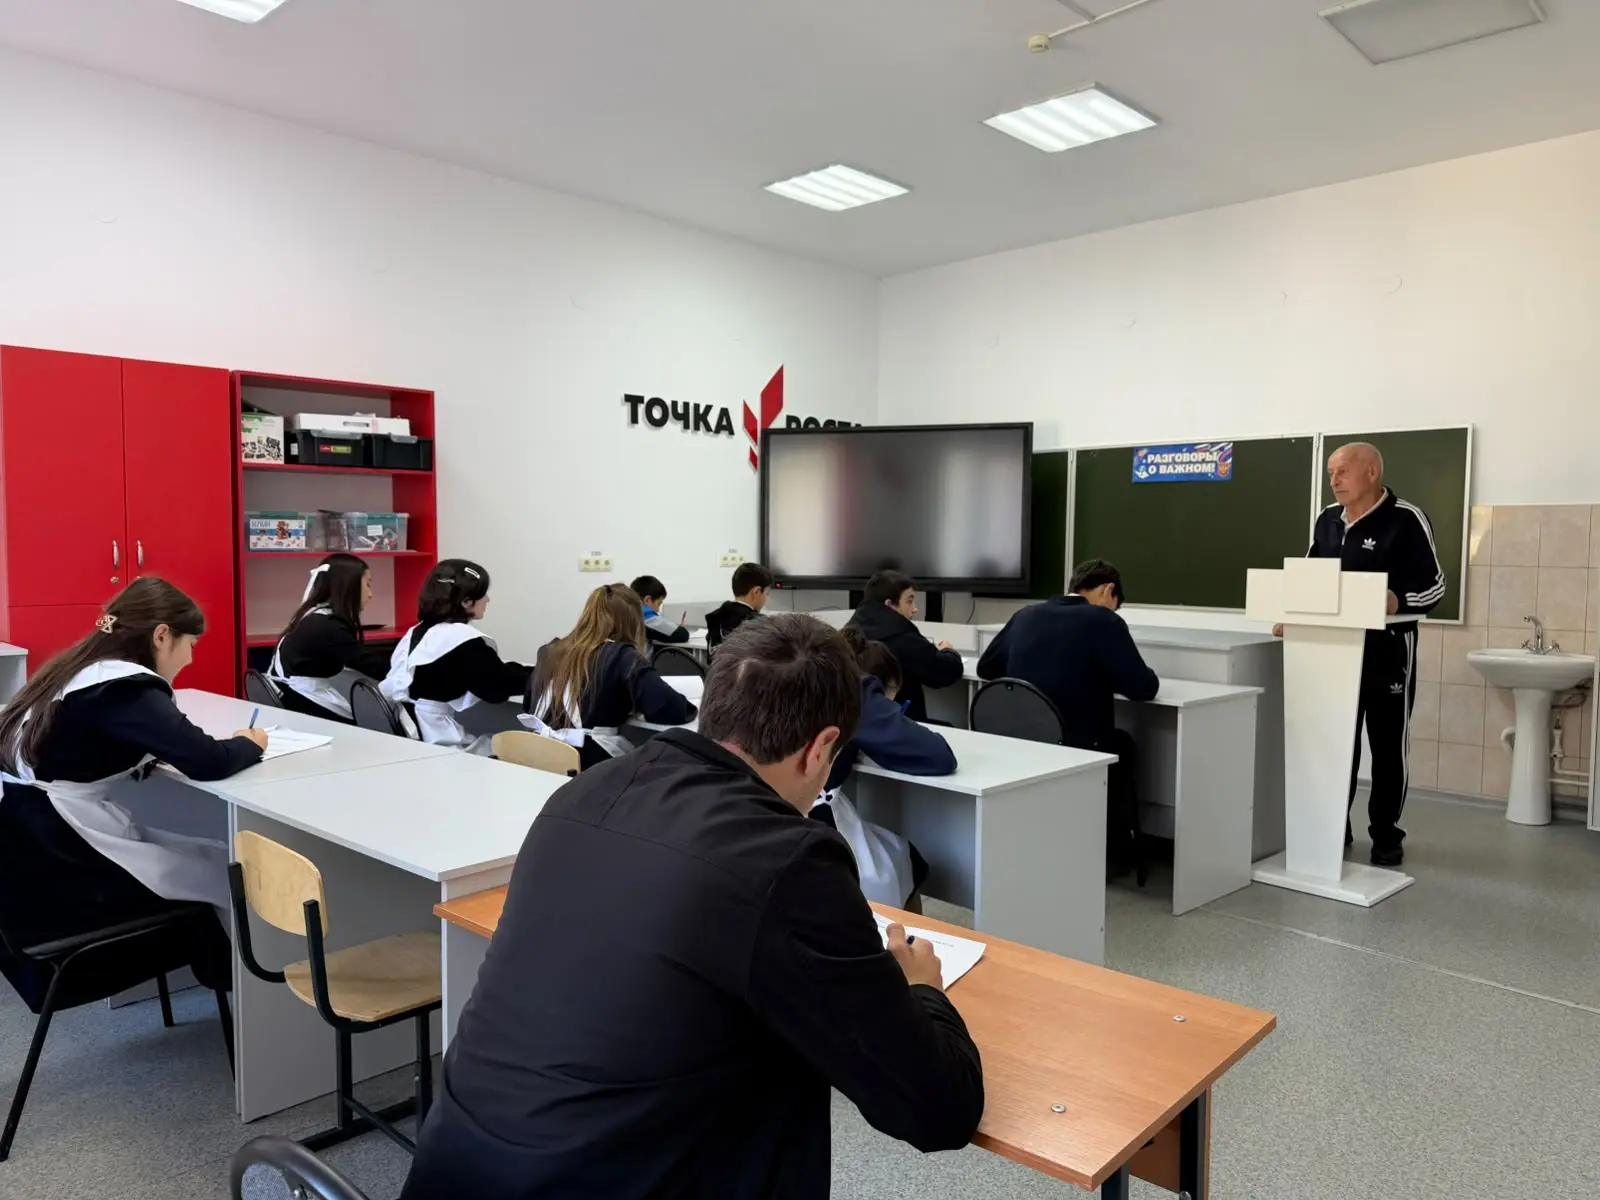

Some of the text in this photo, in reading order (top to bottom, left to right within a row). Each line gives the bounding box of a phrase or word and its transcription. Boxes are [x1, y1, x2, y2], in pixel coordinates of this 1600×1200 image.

[624, 393, 736, 436] ТОЧКА
[1147, 451, 1218, 464] РАЗГОВОРЫ
[1148, 463, 1216, 475] О ВАЖНОМ!
